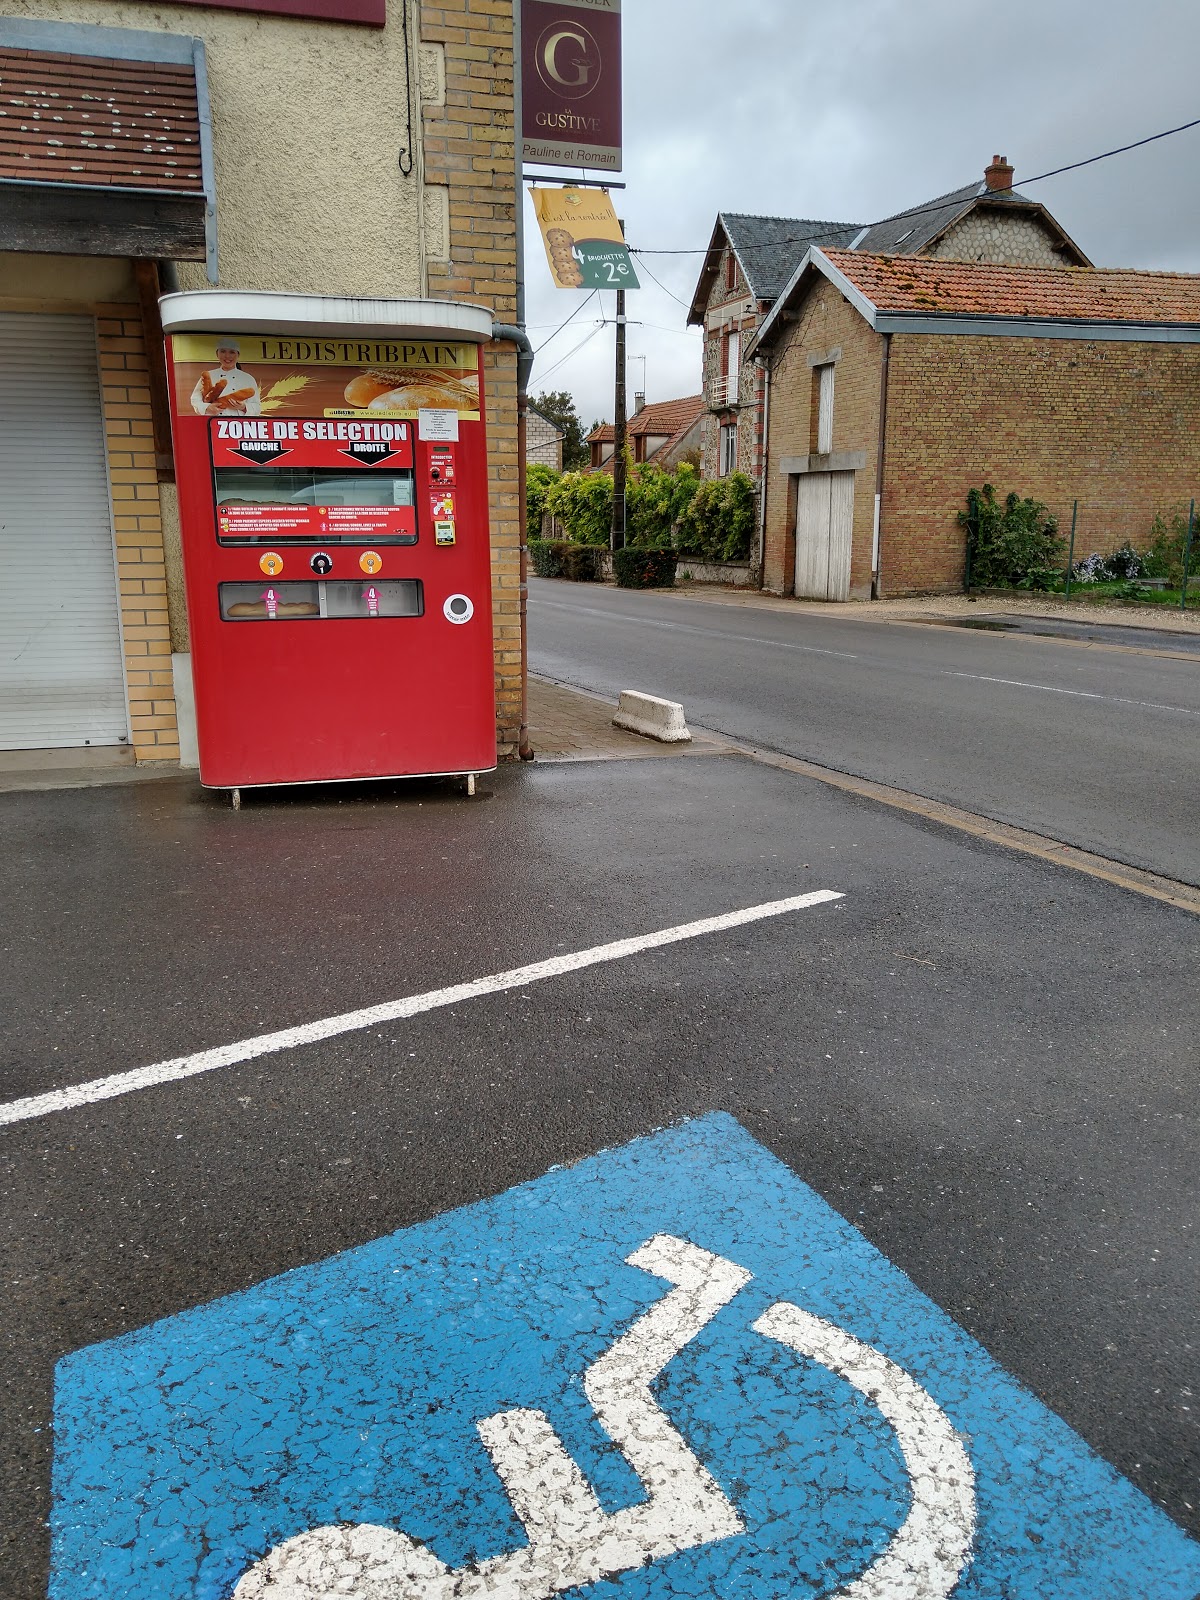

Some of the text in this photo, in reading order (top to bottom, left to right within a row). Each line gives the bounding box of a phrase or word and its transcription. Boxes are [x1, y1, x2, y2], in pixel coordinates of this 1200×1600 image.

[535, 112, 600, 131] GUSTIVE
[522, 143, 616, 164] Pauline et Romain
[564, 210, 576, 222] la
[571, 245, 625, 265] 4 BRIOCHETTES
[602, 262, 629, 282] 2€
[261, 340, 458, 364] LEDISTRIBPAIN
[217, 420, 269, 440] ZONE
[273, 422, 299, 440] DE
[302, 422, 407, 441] SELECTION
[241, 442, 279, 452] GAUCHE
[353, 443, 386, 453] DROITE
[269, 567, 275, 575] 3
[267, 589, 275, 600] 4
[368, 588, 376, 599] 4
